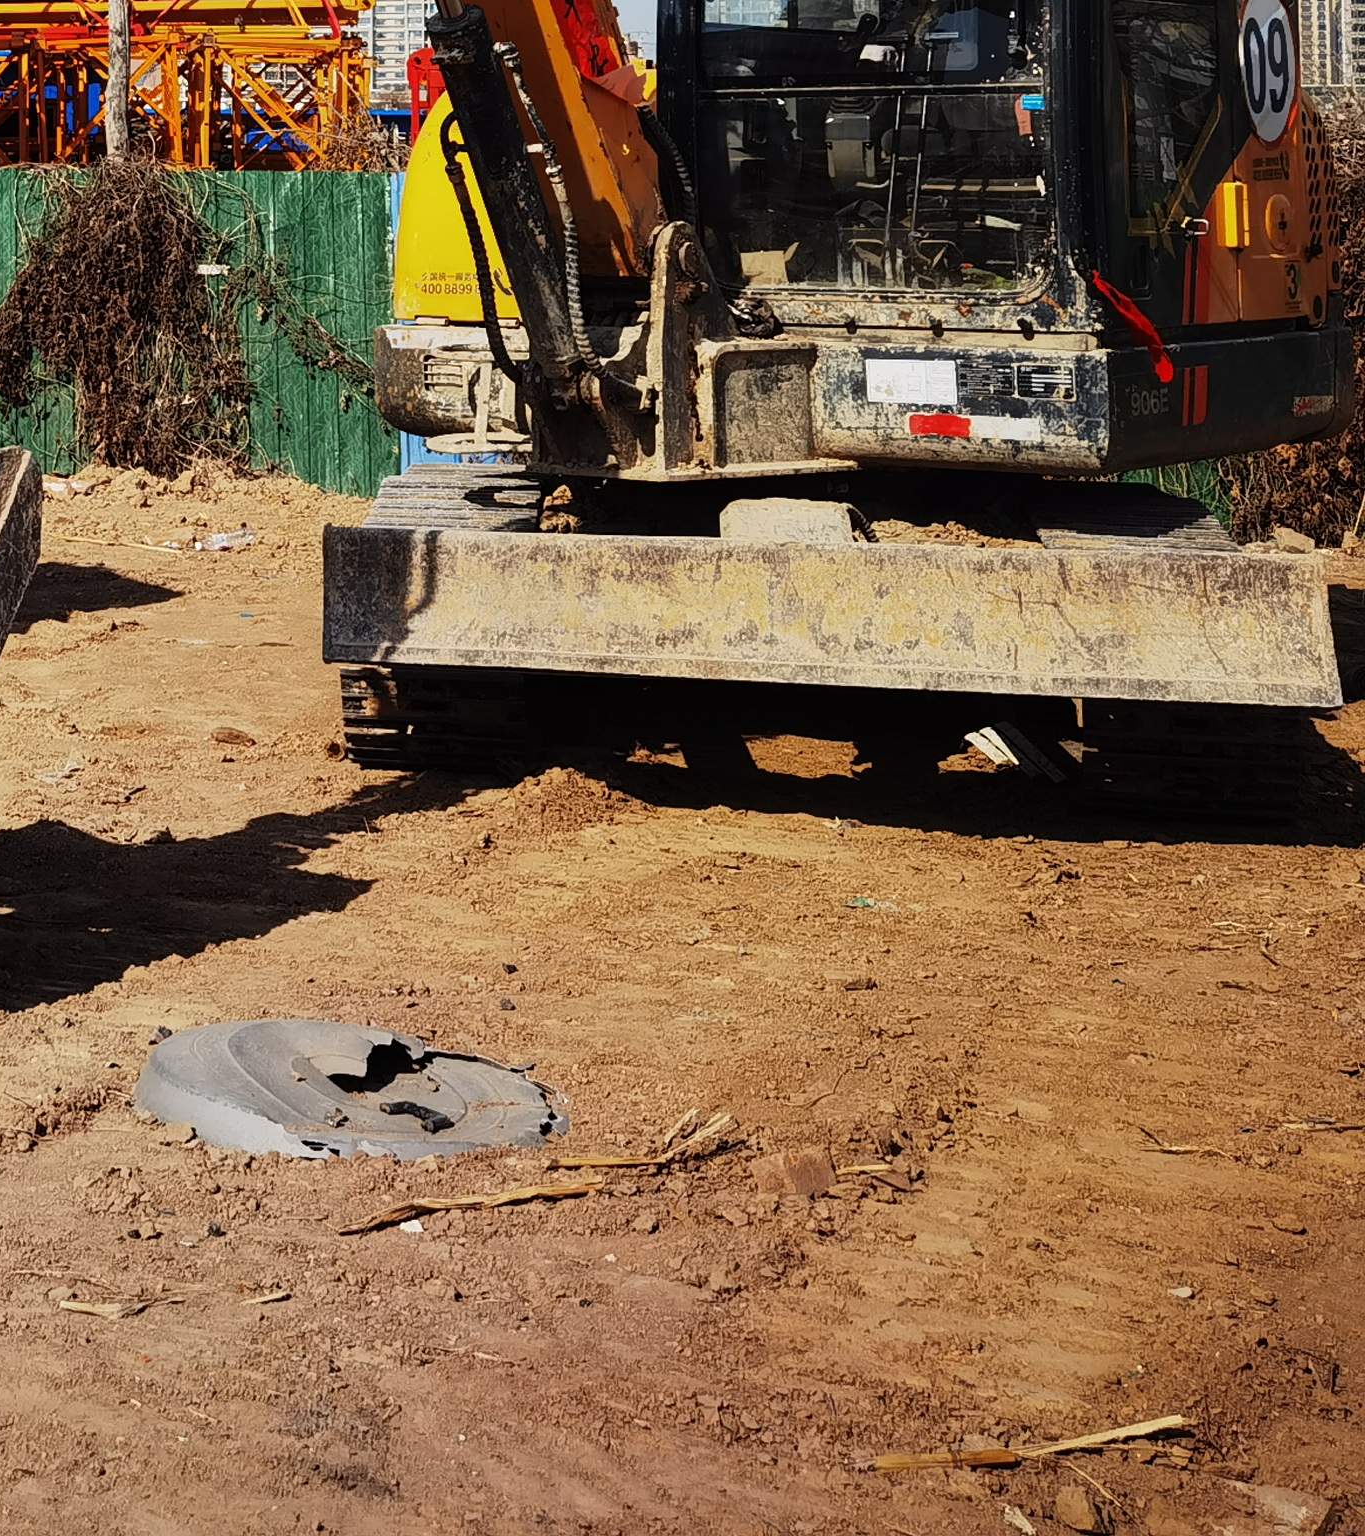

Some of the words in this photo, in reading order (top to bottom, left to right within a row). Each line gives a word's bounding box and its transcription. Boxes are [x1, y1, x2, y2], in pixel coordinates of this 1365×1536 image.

[1243, 17, 1290, 115] 09
[421, 283, 442, 295] 400
[444, 283, 473, 295] 8899
[1131, 387, 1170, 416] 906E
